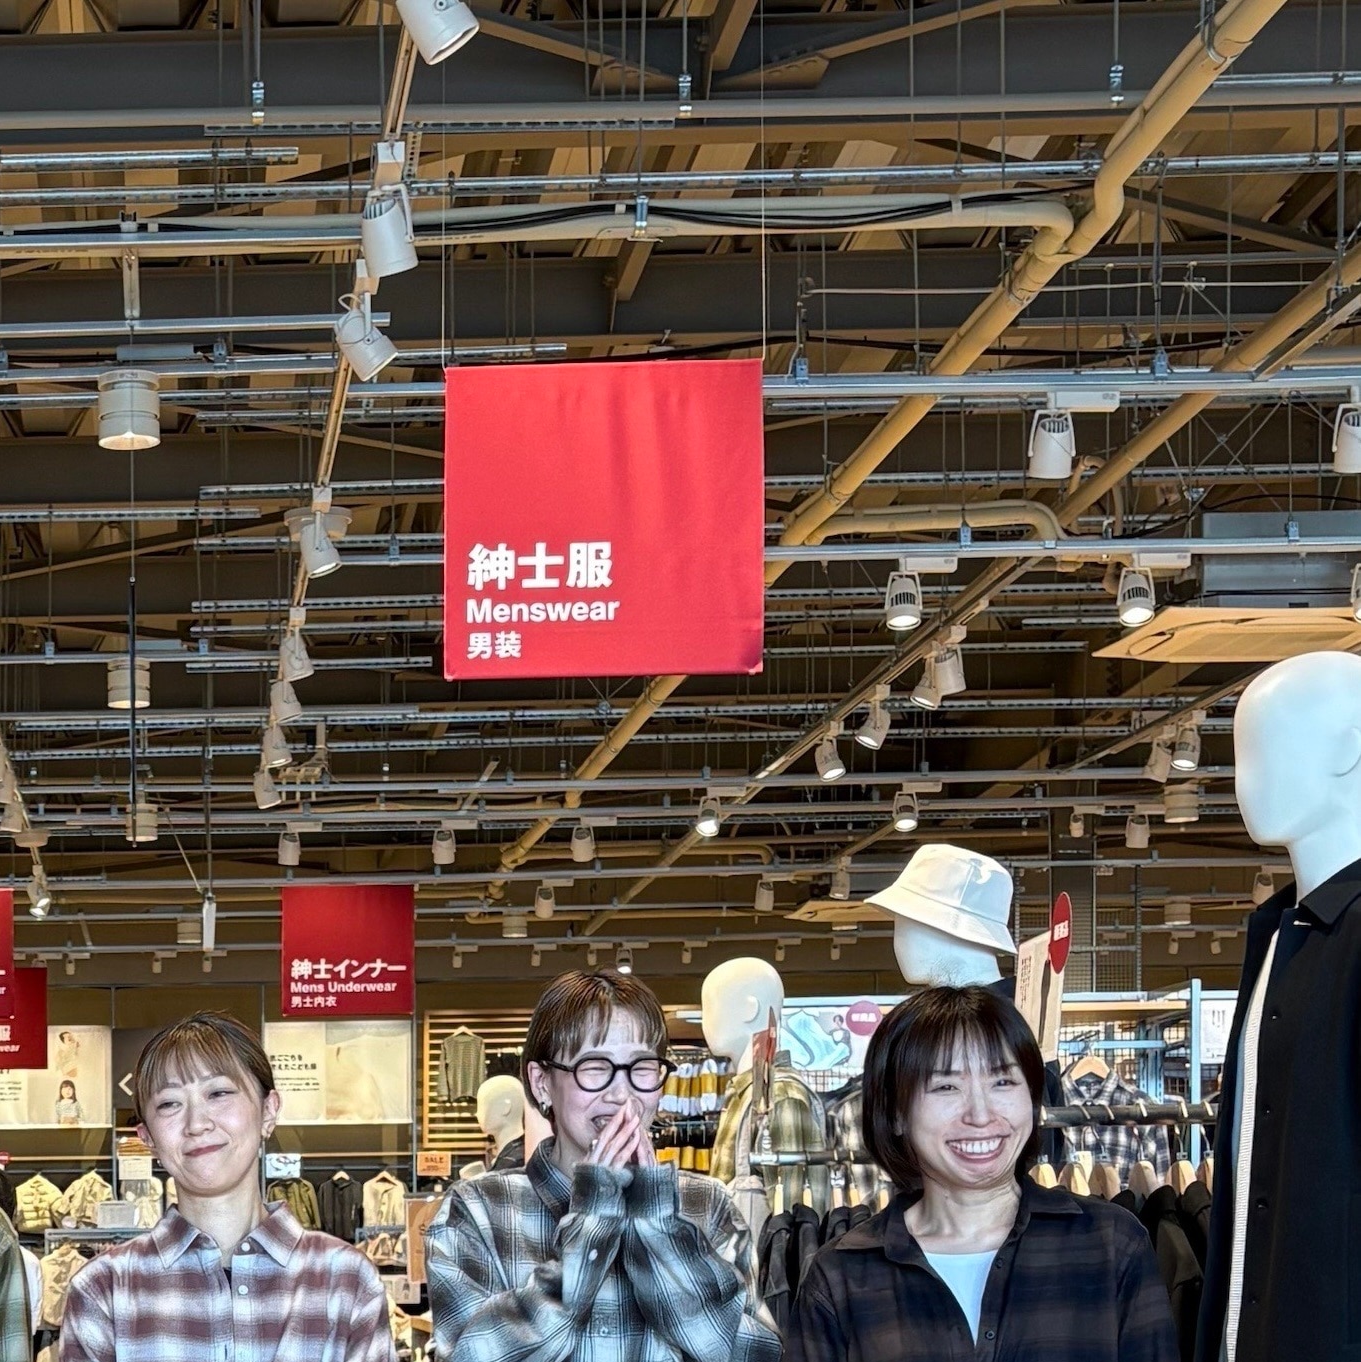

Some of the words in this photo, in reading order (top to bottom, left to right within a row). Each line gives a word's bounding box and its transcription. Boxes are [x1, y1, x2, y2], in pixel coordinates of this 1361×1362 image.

[467, 541, 613, 591] 紳士服
[466, 597, 621, 624] Menswear
[466, 630, 522, 660] 男装
[290, 958, 407, 979] 紳士インナー
[290, 982, 325, 993] Mens
[328, 981, 397, 993] Underwear
